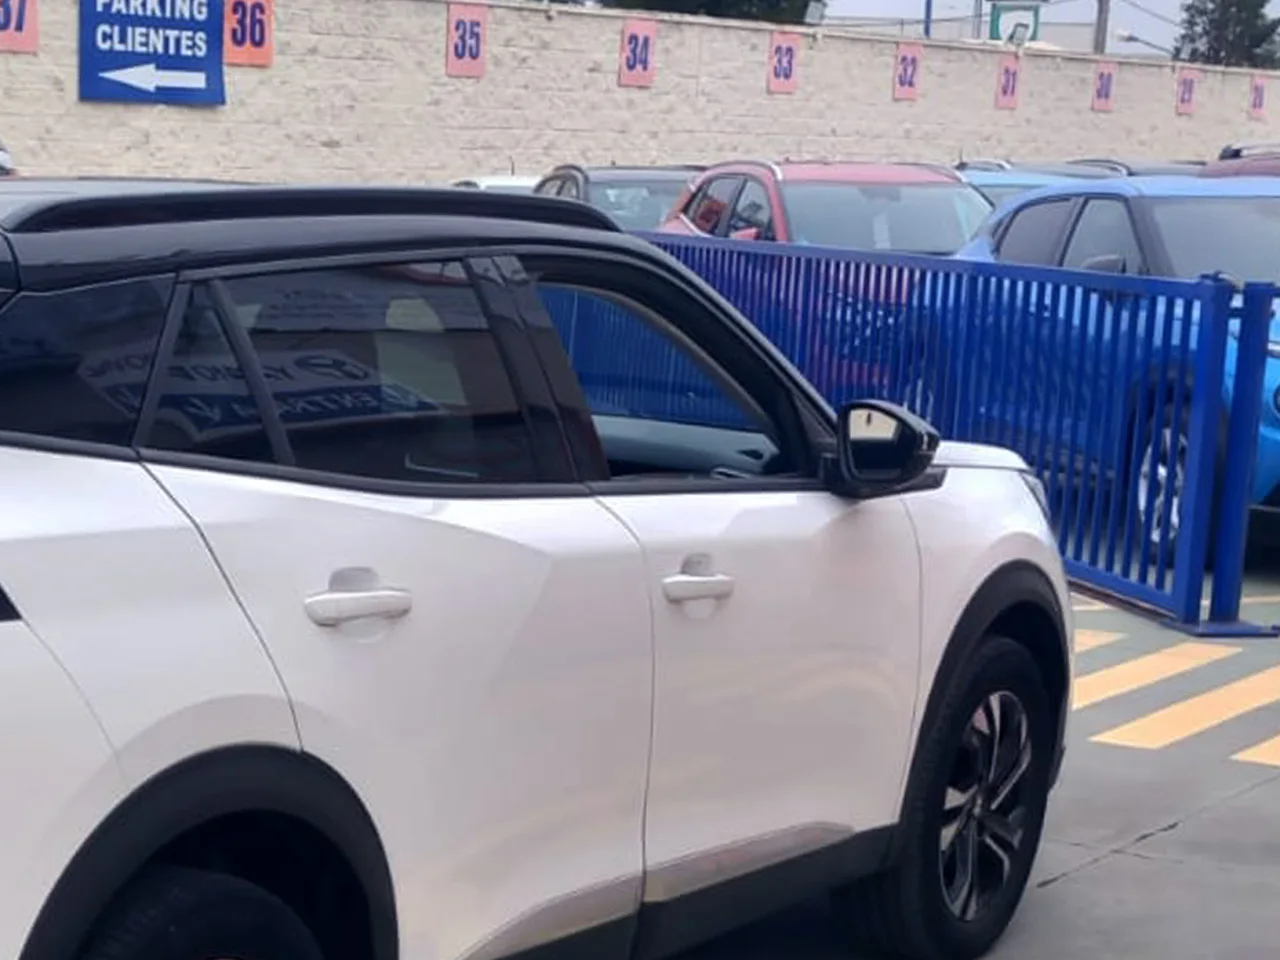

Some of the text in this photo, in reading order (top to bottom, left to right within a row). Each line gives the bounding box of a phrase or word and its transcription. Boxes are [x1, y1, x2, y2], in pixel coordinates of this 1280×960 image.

[95, 0, 208, 21] PARKING
[231, 1, 266, 48] 36
[95, 24, 208, 58] CLIENTES
[453, 20, 481, 60] 35
[625, 34, 649, 71] 34
[773, 46, 794, 79] 33
[898, 55, 917, 88] 32
